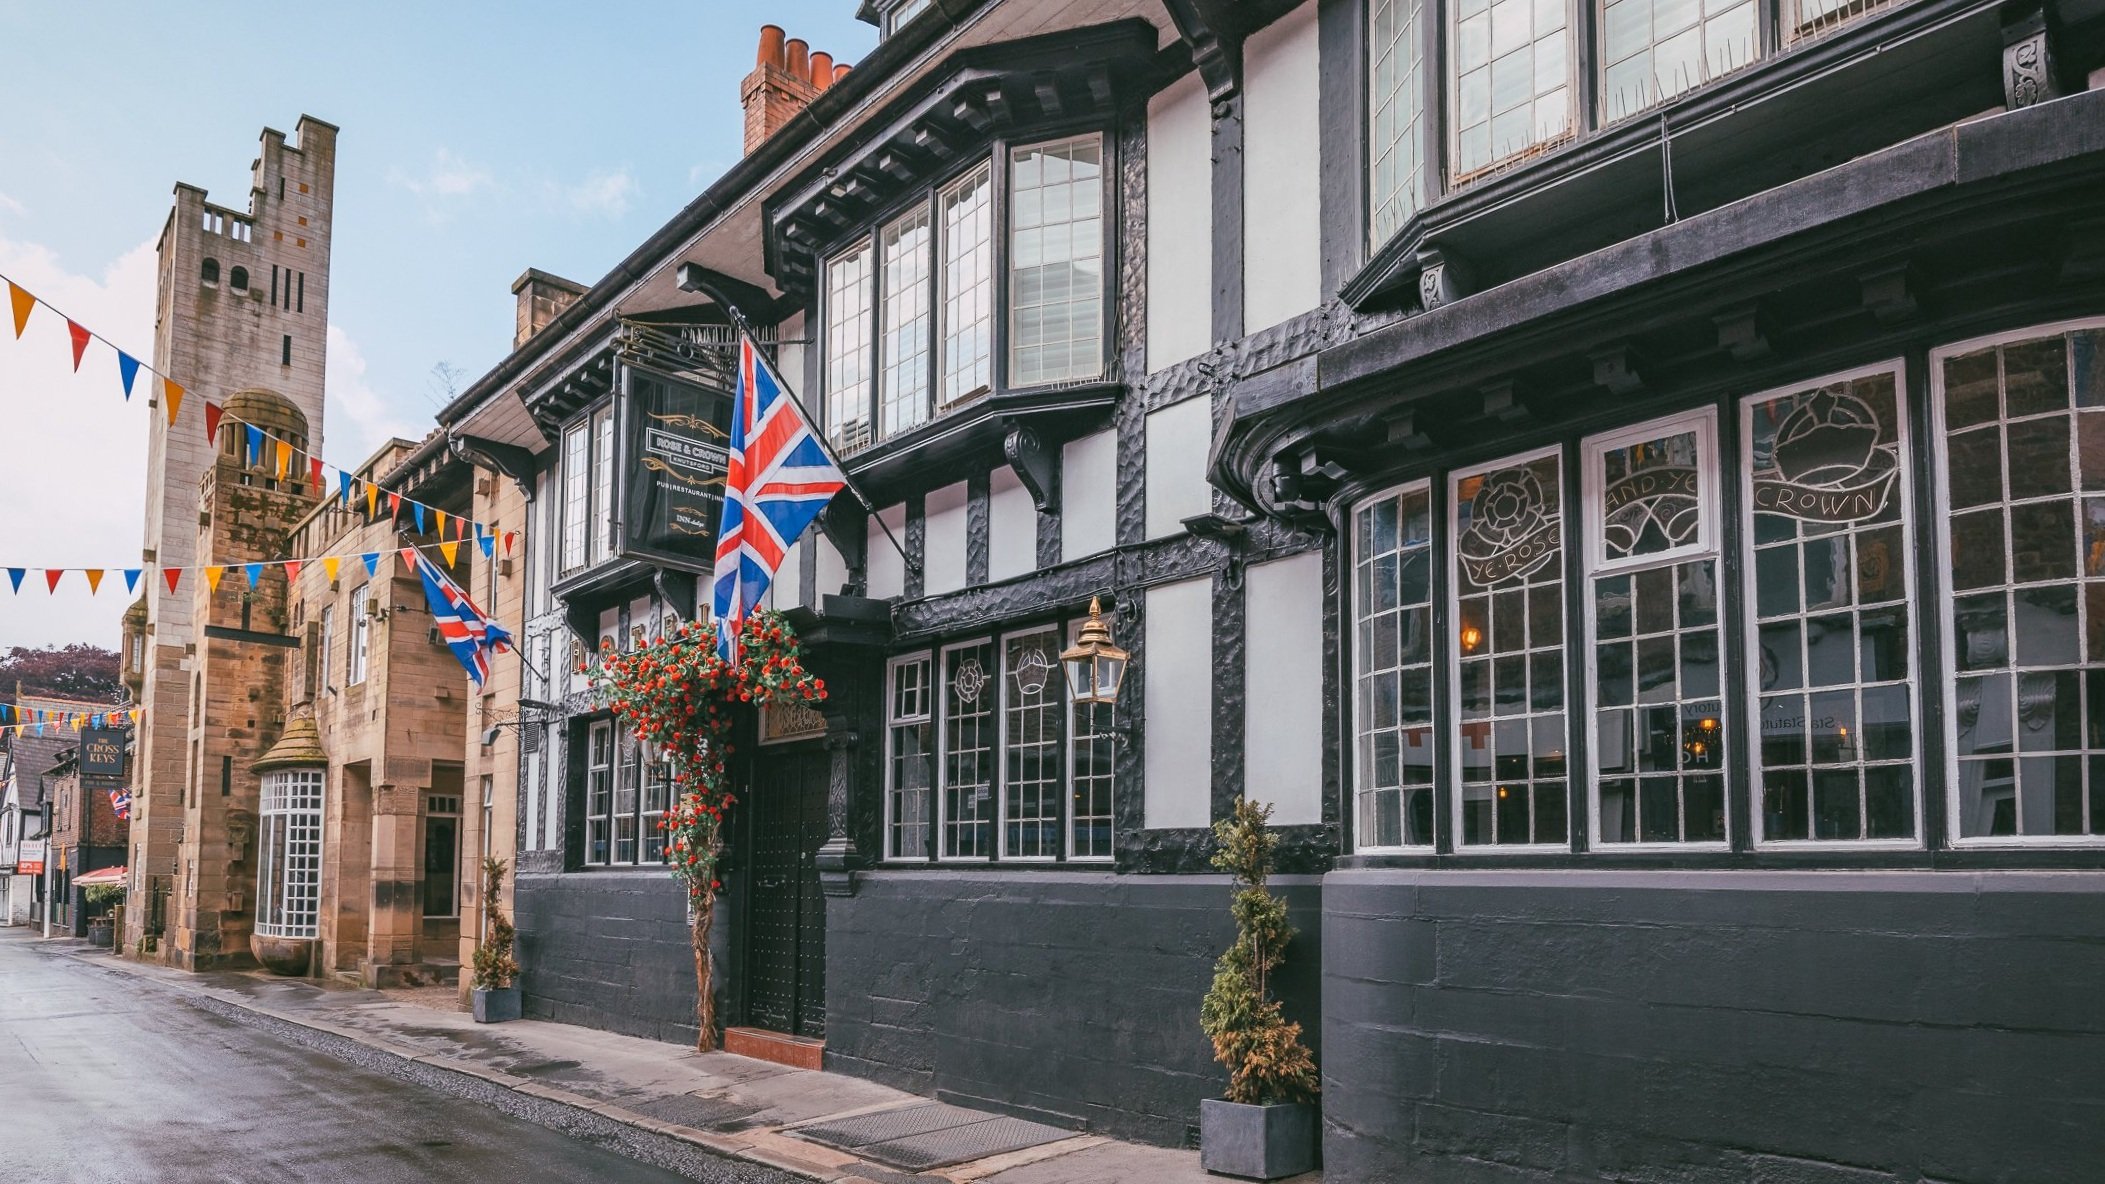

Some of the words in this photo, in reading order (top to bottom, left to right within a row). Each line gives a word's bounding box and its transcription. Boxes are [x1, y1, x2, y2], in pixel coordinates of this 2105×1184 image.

[656, 436, 682, 453] ROSE
[683, 444, 692, 455] &
[692, 447, 727, 465] CROWN
[673, 456, 710, 471] KNUTSFORD
[1606, 475, 1655, 513] AND
[1755, 486, 1875, 515] CROWN
[1504, 528, 1560, 571] ROSE
[86, 743, 120, 754] CROSS
[90, 753, 116, 764] KEYS
